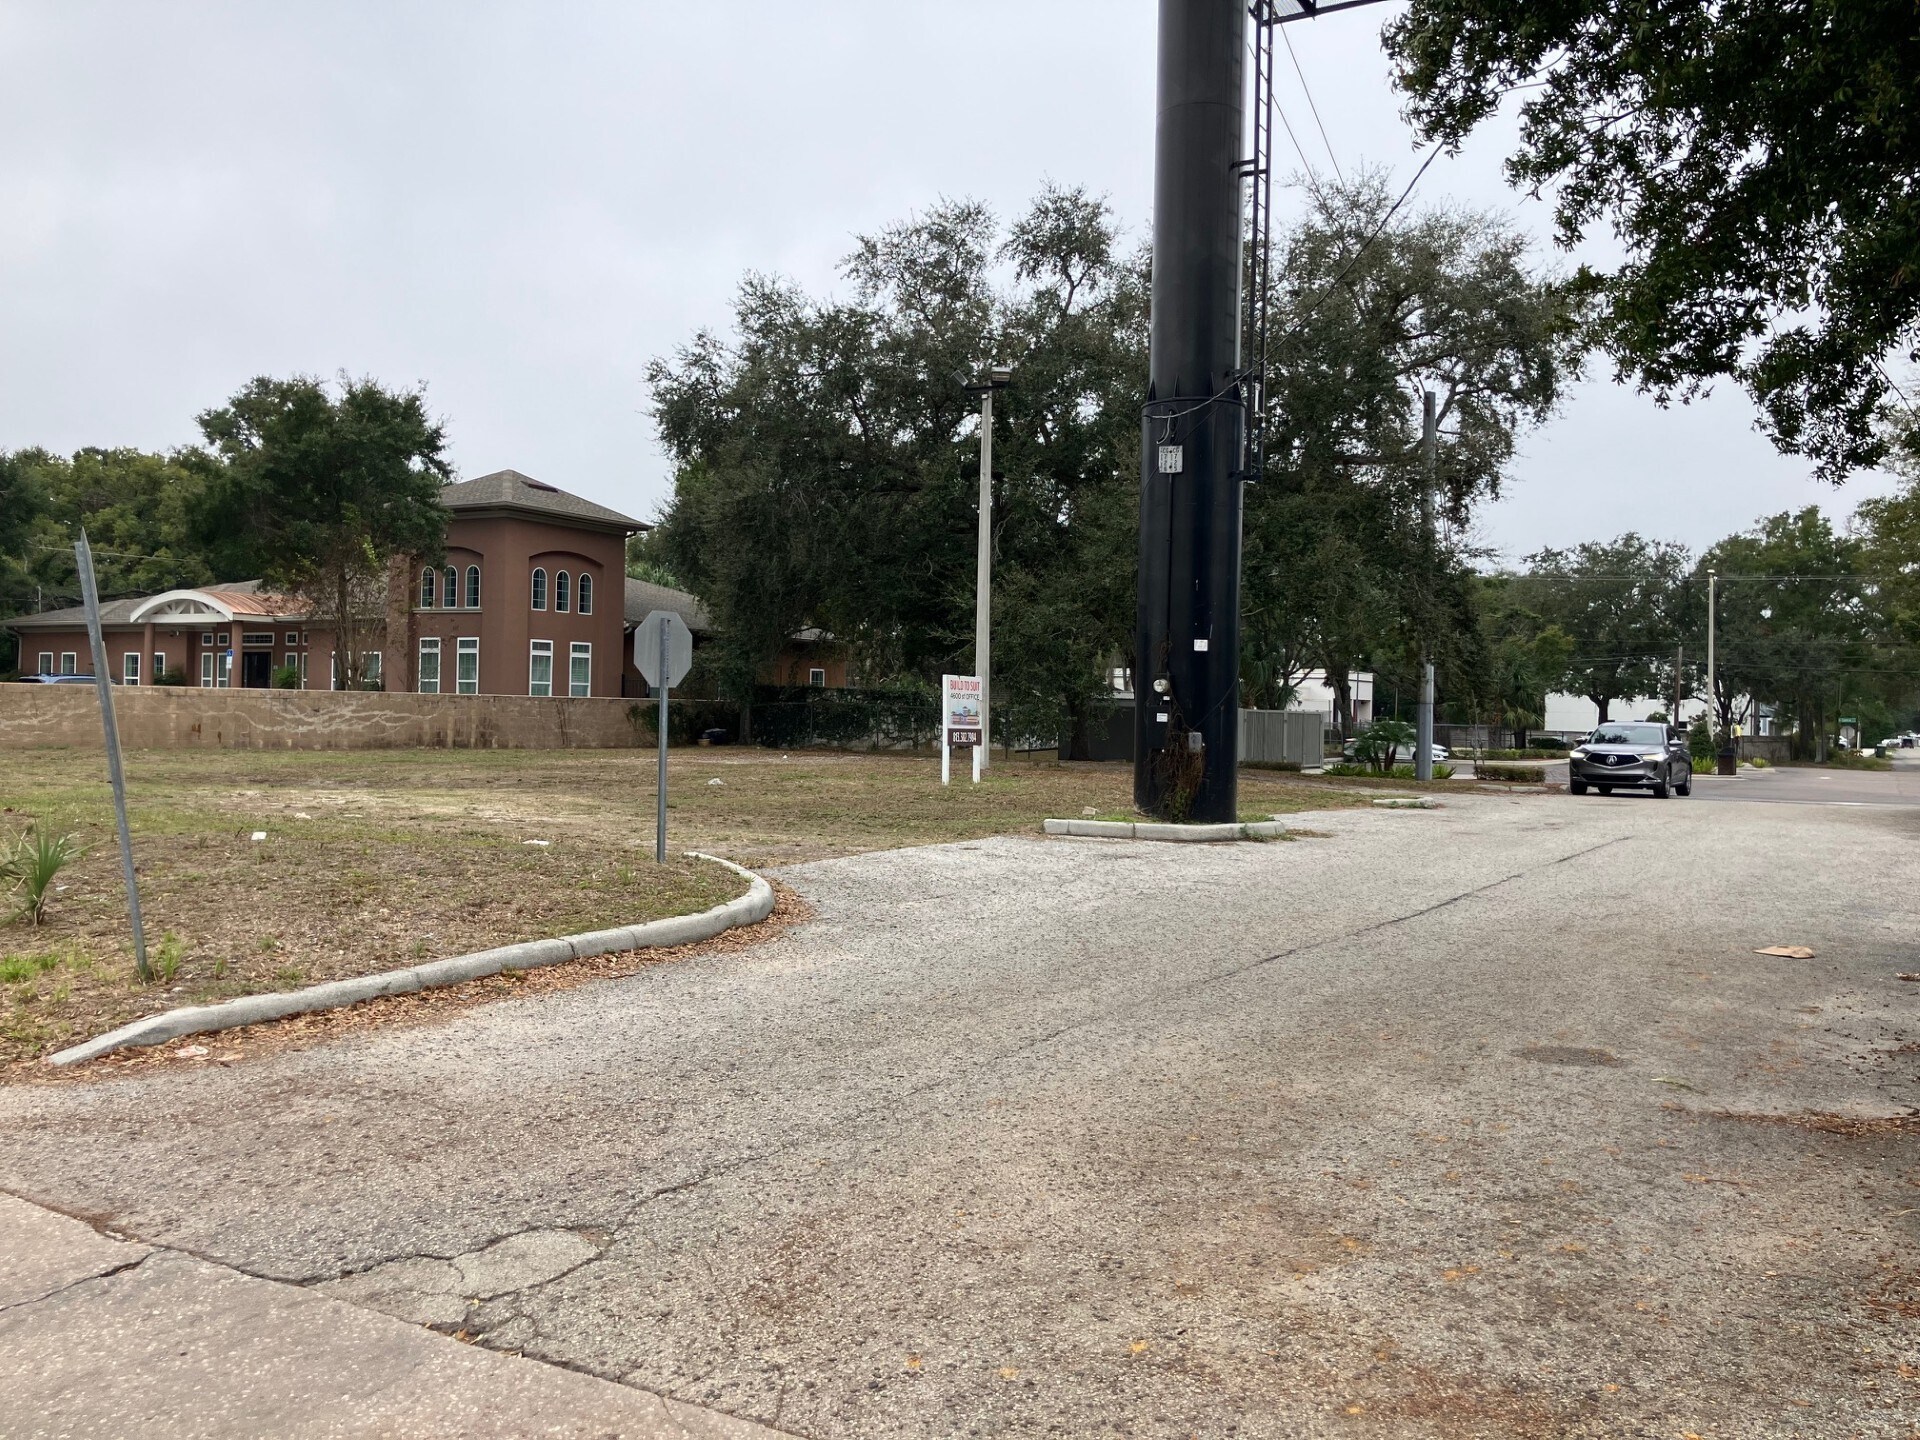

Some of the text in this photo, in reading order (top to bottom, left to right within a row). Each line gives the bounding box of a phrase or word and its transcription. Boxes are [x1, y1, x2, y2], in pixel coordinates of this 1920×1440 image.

[950, 680, 980, 691] BUILD TO SUIT
[965, 693, 980, 701] OFFICE
